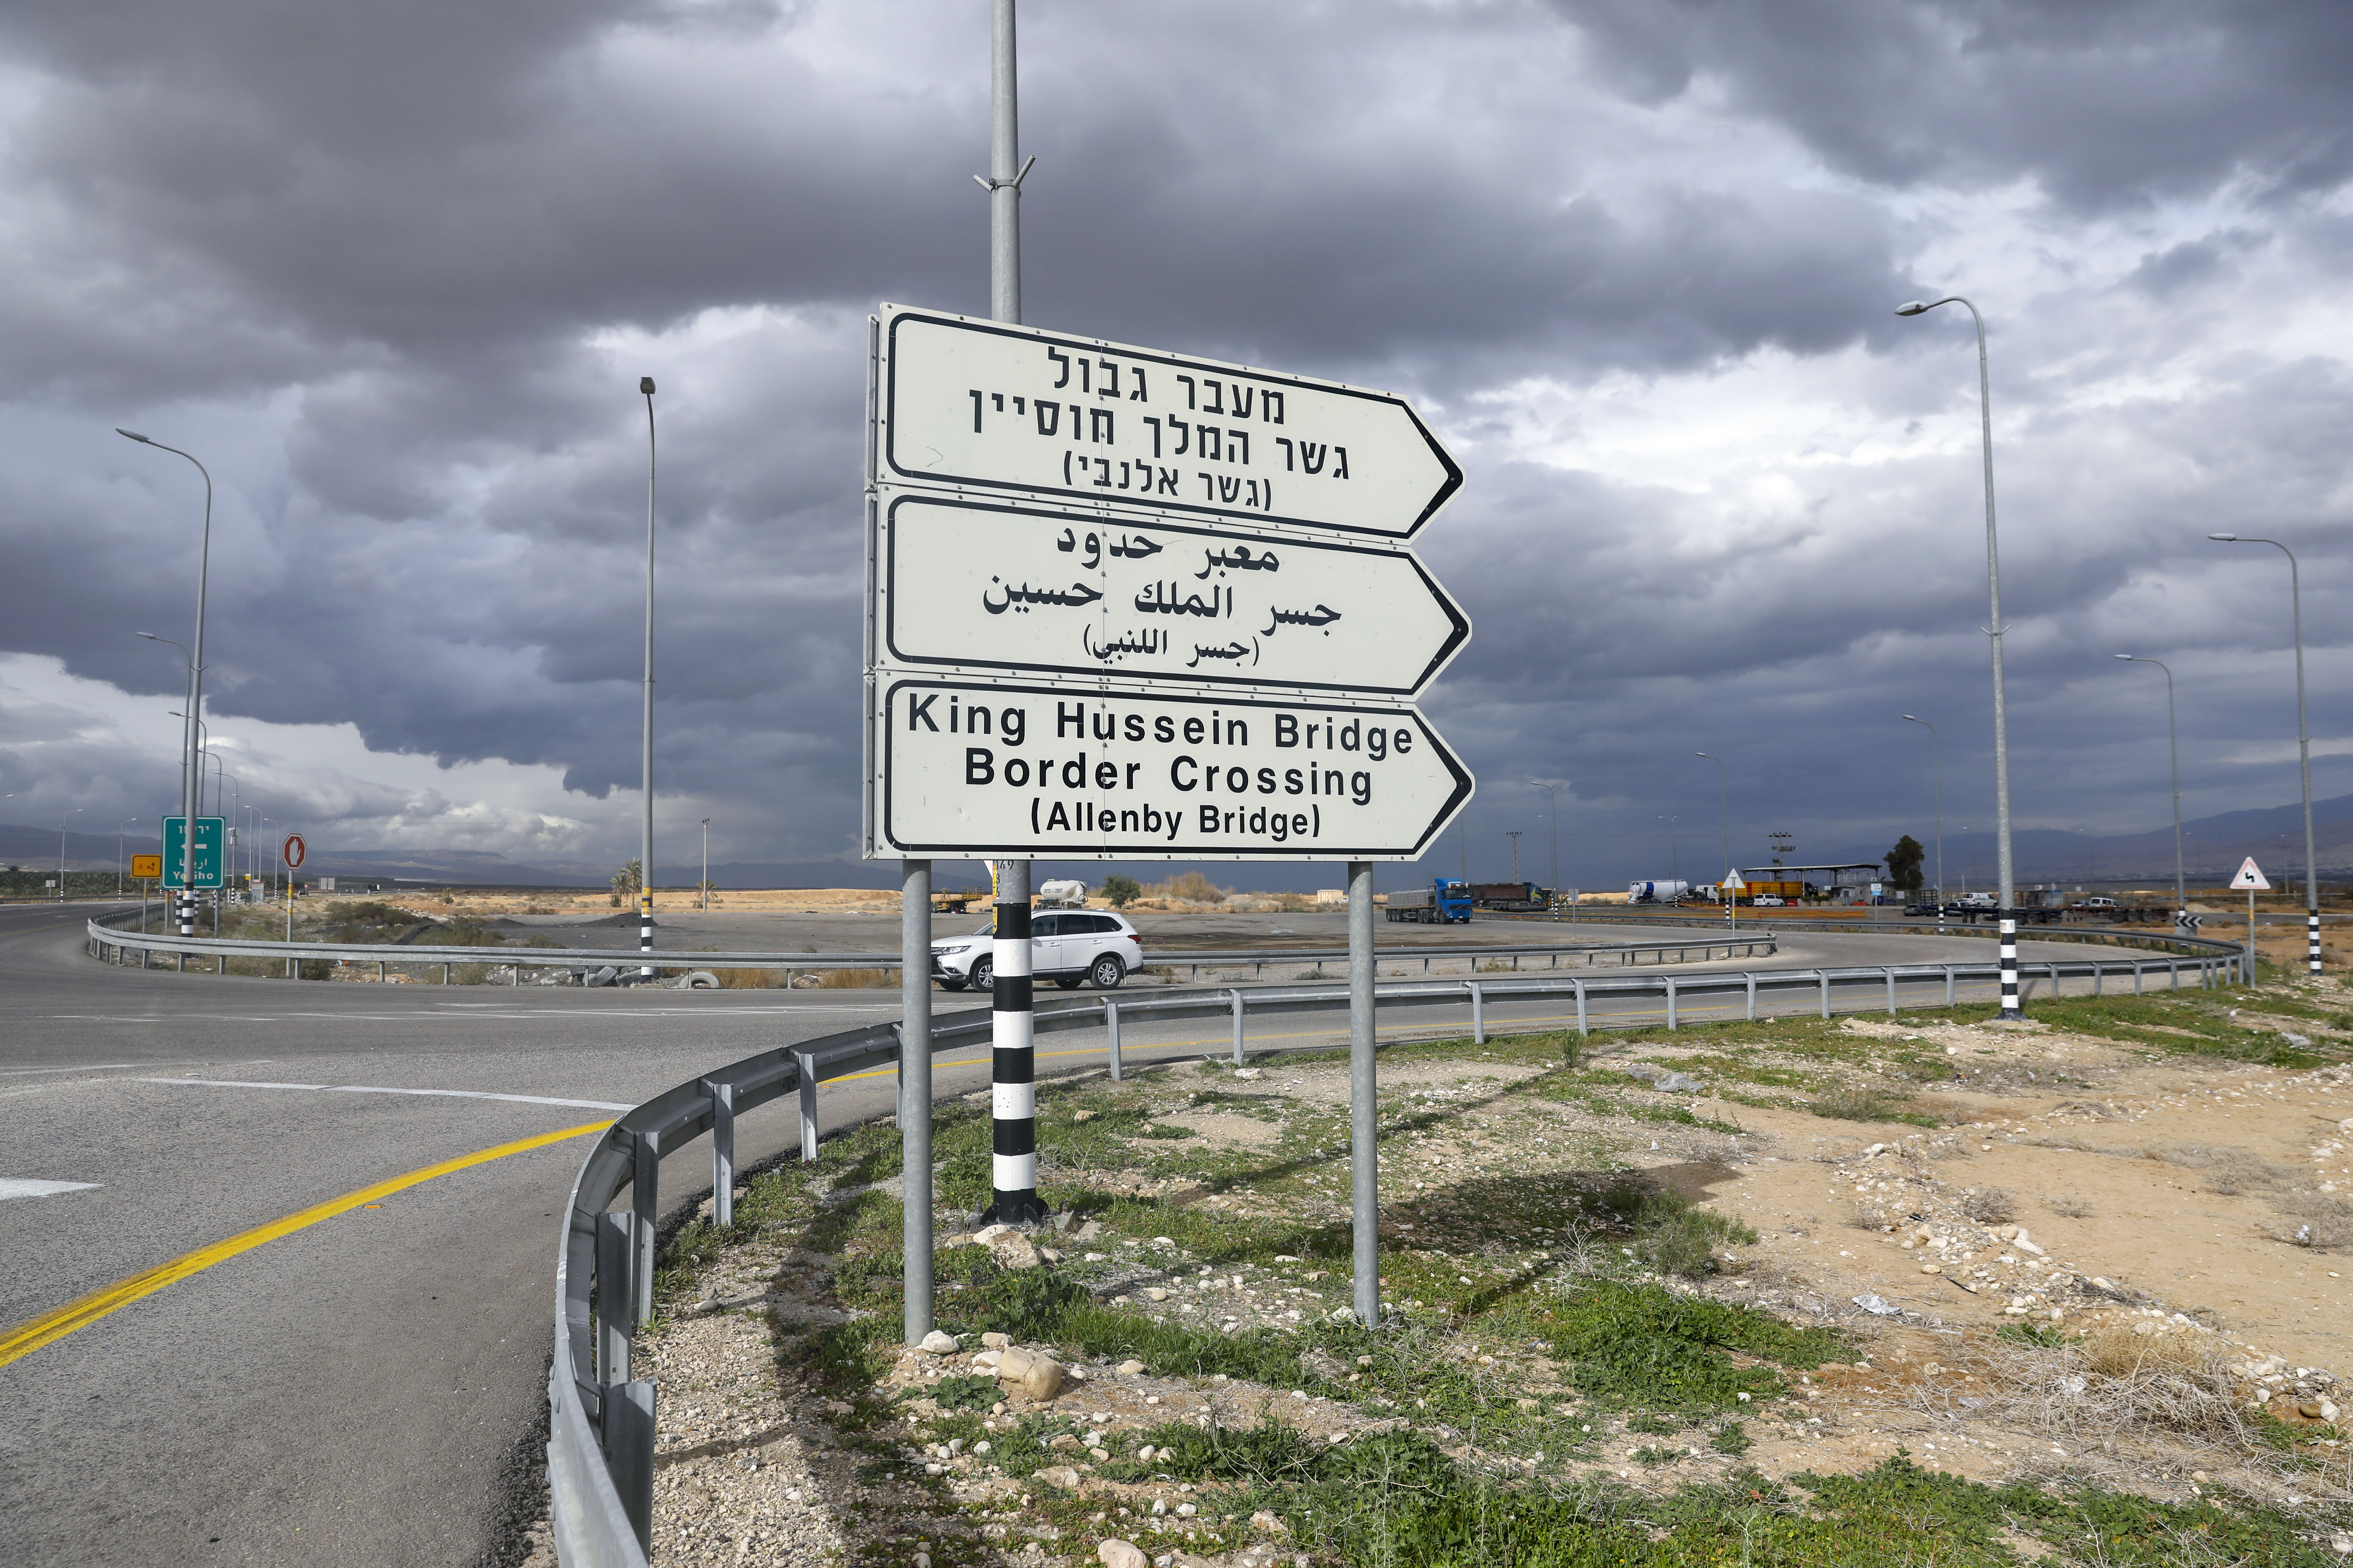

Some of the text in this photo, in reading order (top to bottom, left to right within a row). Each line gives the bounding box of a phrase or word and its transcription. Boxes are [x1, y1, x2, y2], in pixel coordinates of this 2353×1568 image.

[1048, 346, 1284, 425] מעבר גבול
[969, 389, 1349, 480] גשר המלך חוסיין
[1064, 451, 1271, 511] (גשר אלנבי)
[1057, 528, 1279, 580] معبر حدود
[983, 576, 1342, 637] جسر الملك حسين
[1084, 624, 1259, 668] (جسر اللنبي)
[909, 693, 1412, 761] King Hussein Bridge
[966, 748, 1371, 806] Border Crossing
[1031, 797, 1320, 842] (Allenby Bridge)
[173, 871, 213, 879] Yeiho
